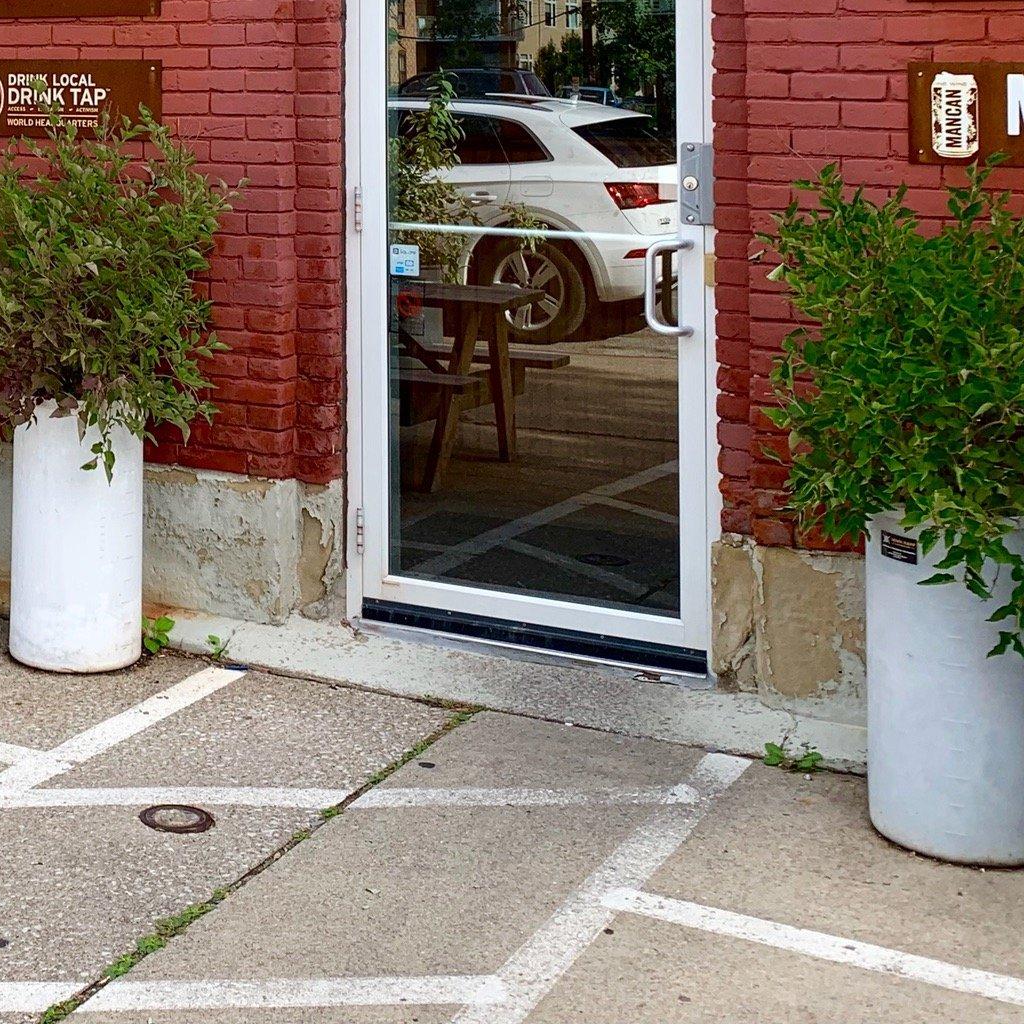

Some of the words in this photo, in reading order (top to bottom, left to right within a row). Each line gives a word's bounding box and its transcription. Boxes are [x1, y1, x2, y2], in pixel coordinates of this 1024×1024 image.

[8, 73, 48, 86] DRINK
[53, 74, 96, 87] LOCAL
[8, 87, 65, 106] DRINK
[7, 118, 34, 126] WORLD
[945, 89, 962, 148] MANCAN
